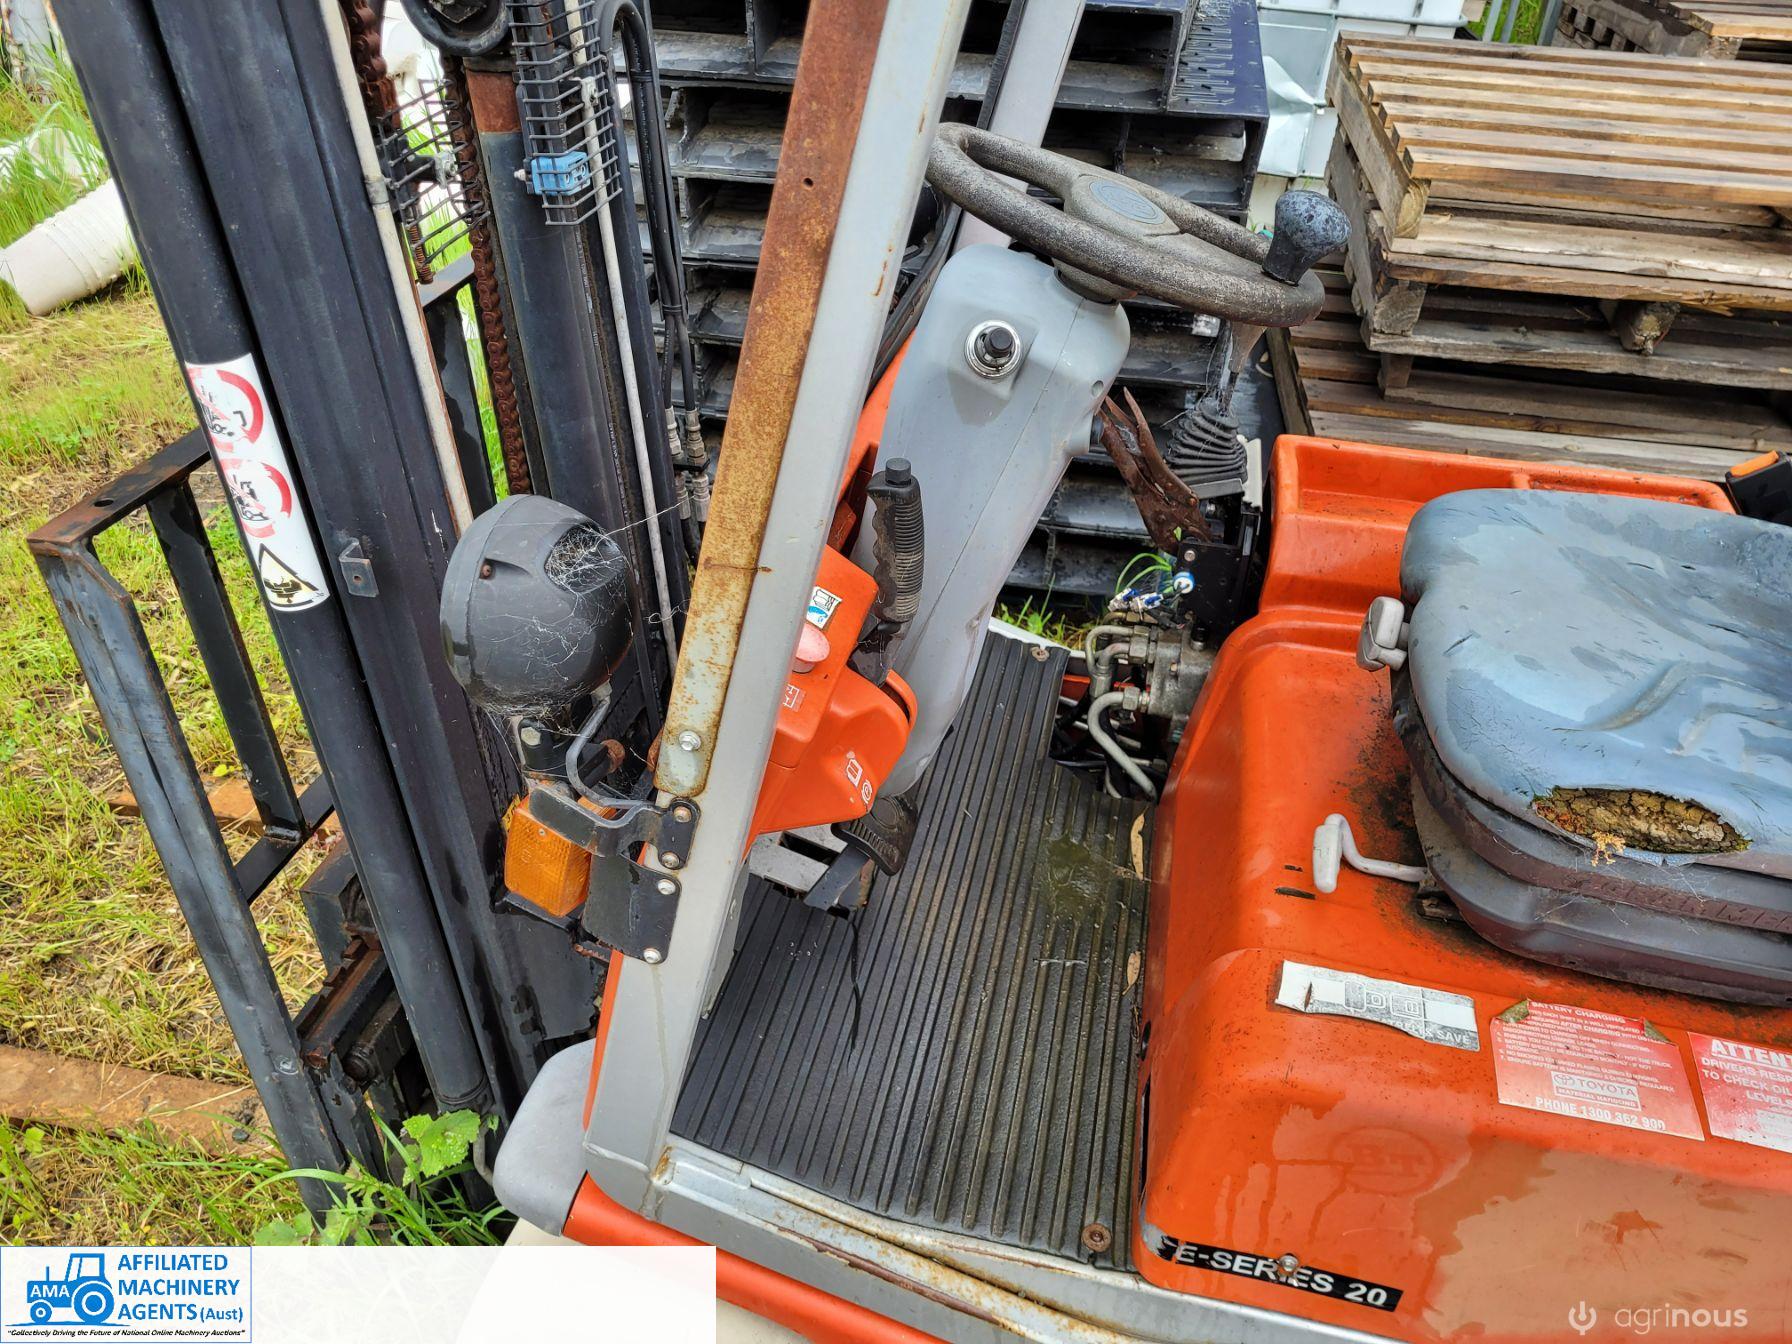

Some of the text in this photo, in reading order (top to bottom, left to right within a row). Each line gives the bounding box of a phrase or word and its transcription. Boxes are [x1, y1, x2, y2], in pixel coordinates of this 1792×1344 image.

[1531, 1002, 1626, 1024] BATTERY CHARGING
[1437, 1029, 1472, 1046] SAVE
[1702, 1057, 1756, 1075] DRIVERS
[1579, 1078, 1637, 1097] TOYOTA
[1702, 1069, 1792, 1096] TO CHECK OIL
[1558, 1087, 1596, 1099] MATERIAL
[1535, 1096, 1577, 1113] PHONE
[1580, 1105, 1611, 1120] 1300
[1344, 1283, 1388, 1306] 20
